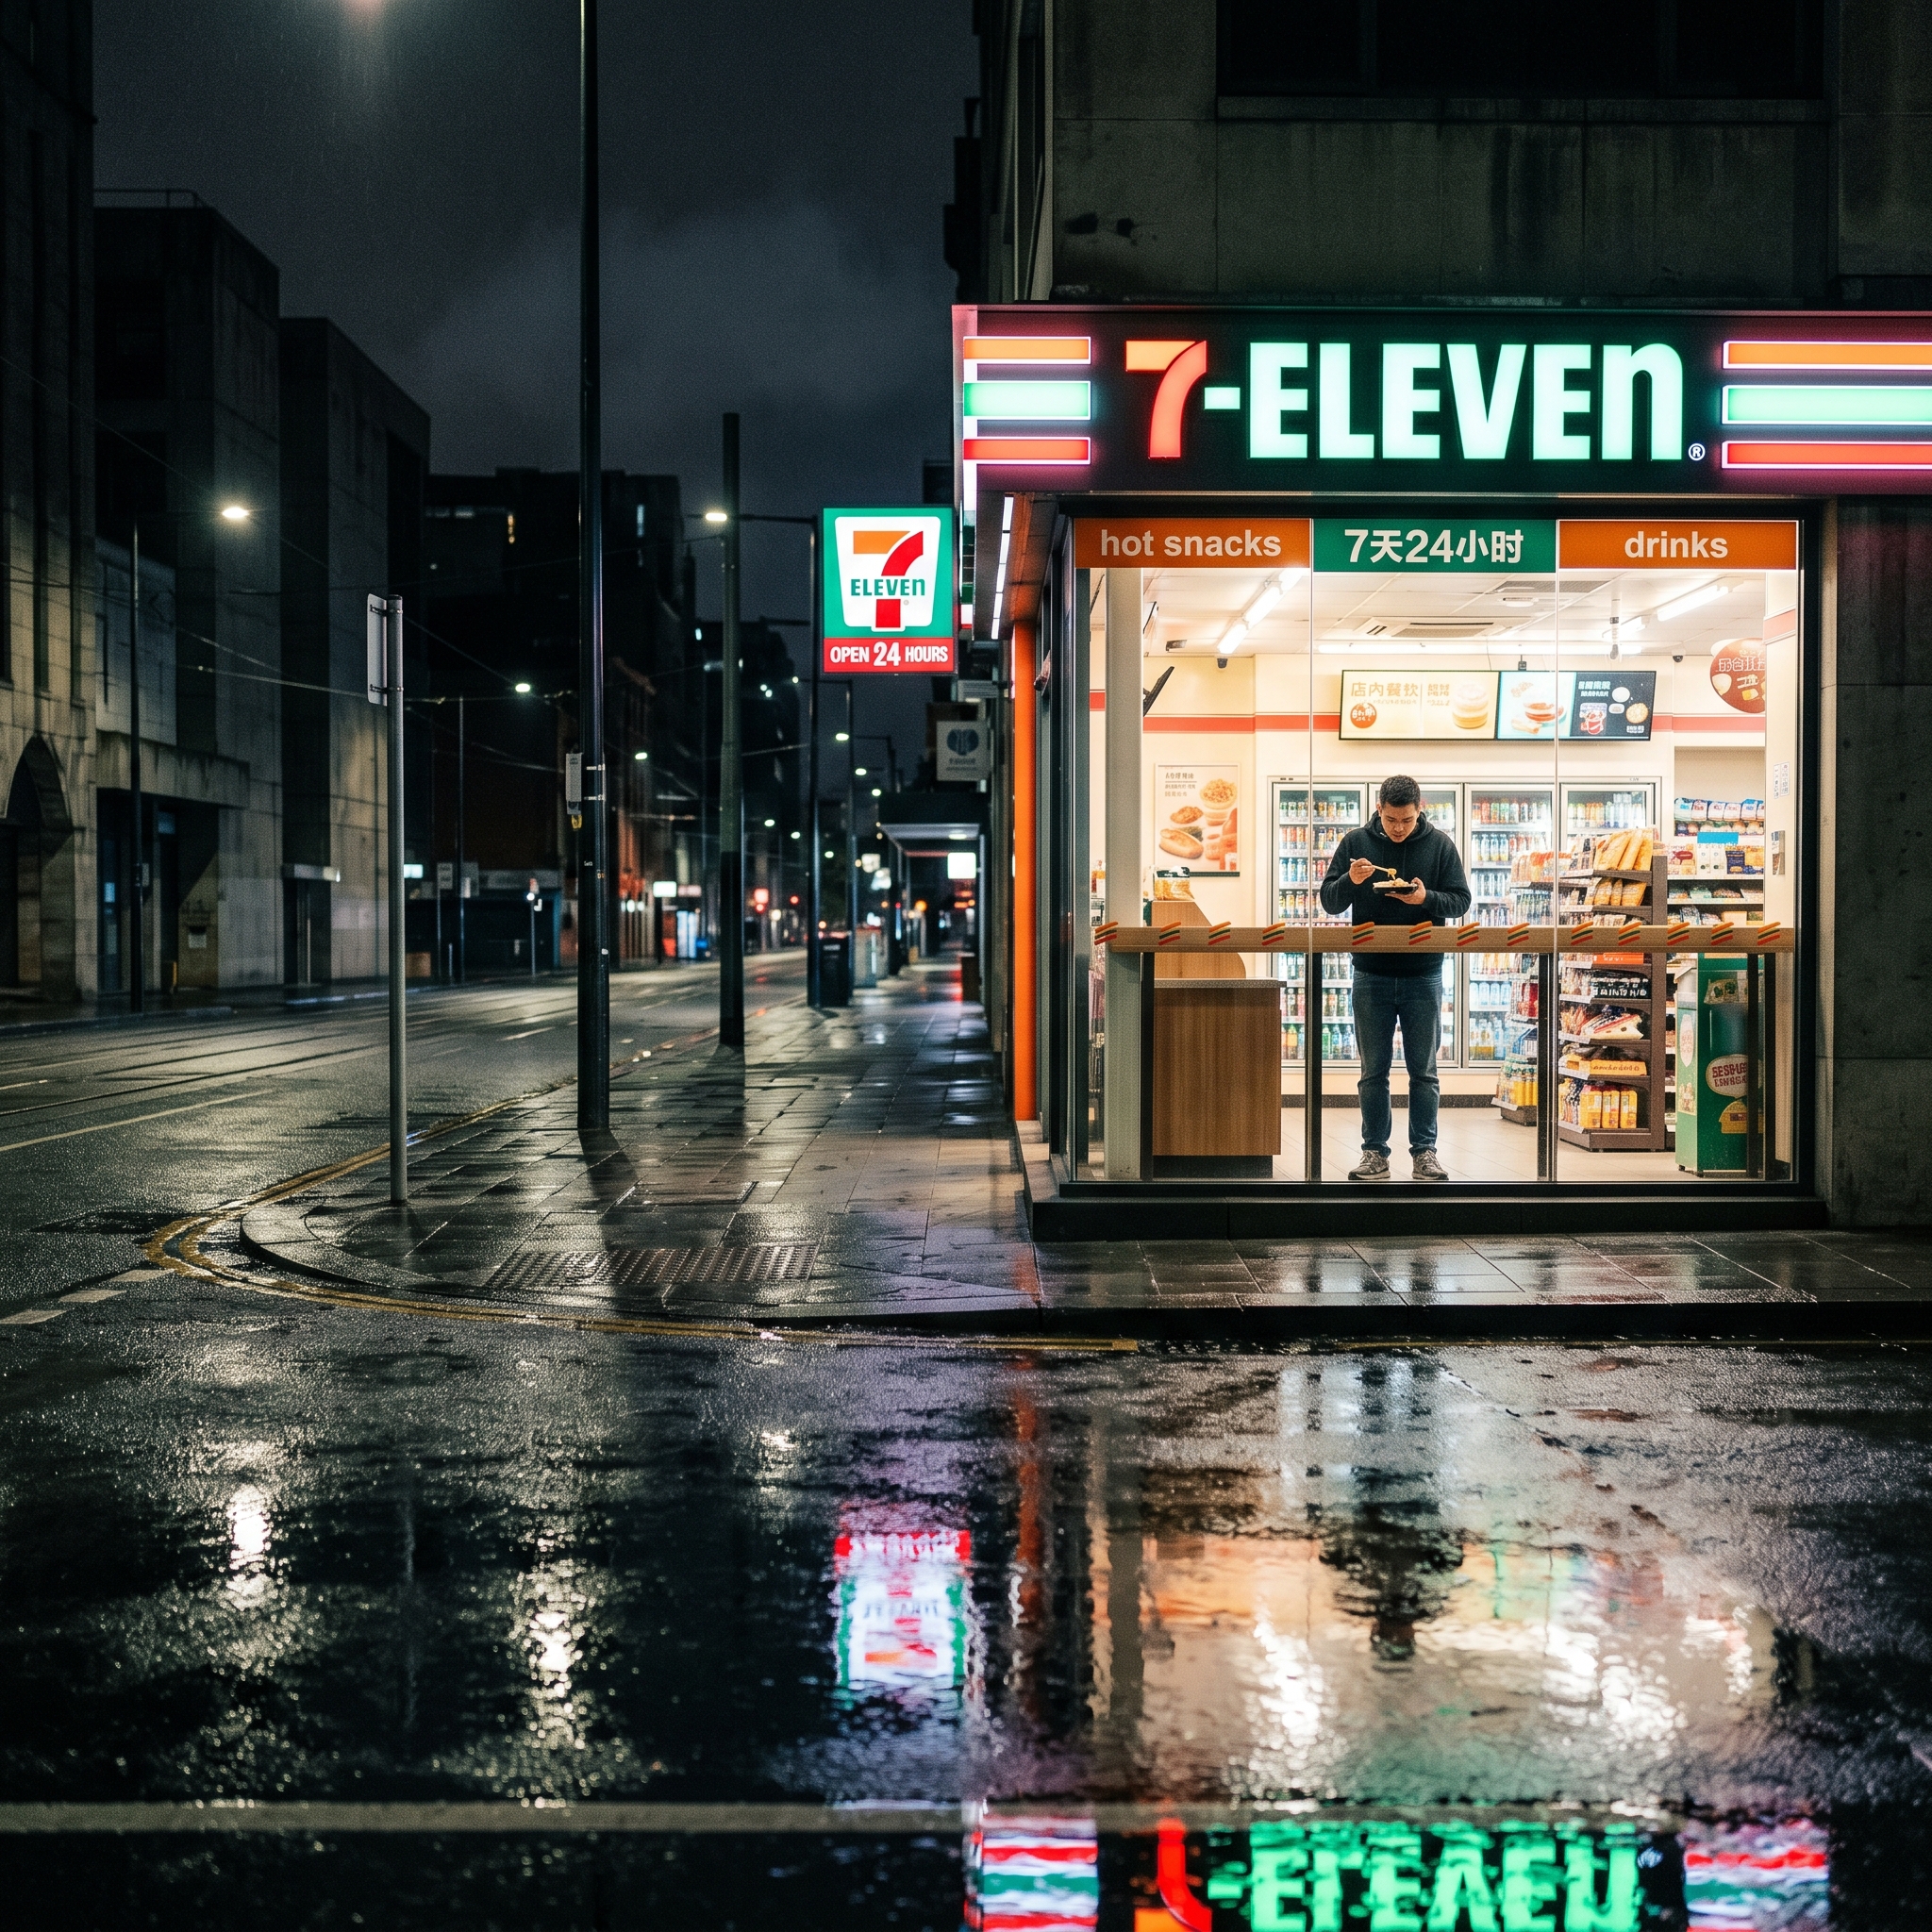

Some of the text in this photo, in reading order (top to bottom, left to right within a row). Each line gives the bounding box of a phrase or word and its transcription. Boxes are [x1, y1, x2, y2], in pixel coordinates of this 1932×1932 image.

[1100, 530, 1282, 558] hot snacks
[1344, 528, 1524, 564] 7天24小时
[1624, 530, 1728, 558] drinks
[853, 530, 924, 628] 7
[830, 641, 948, 666] OPEN 24 HOURS
